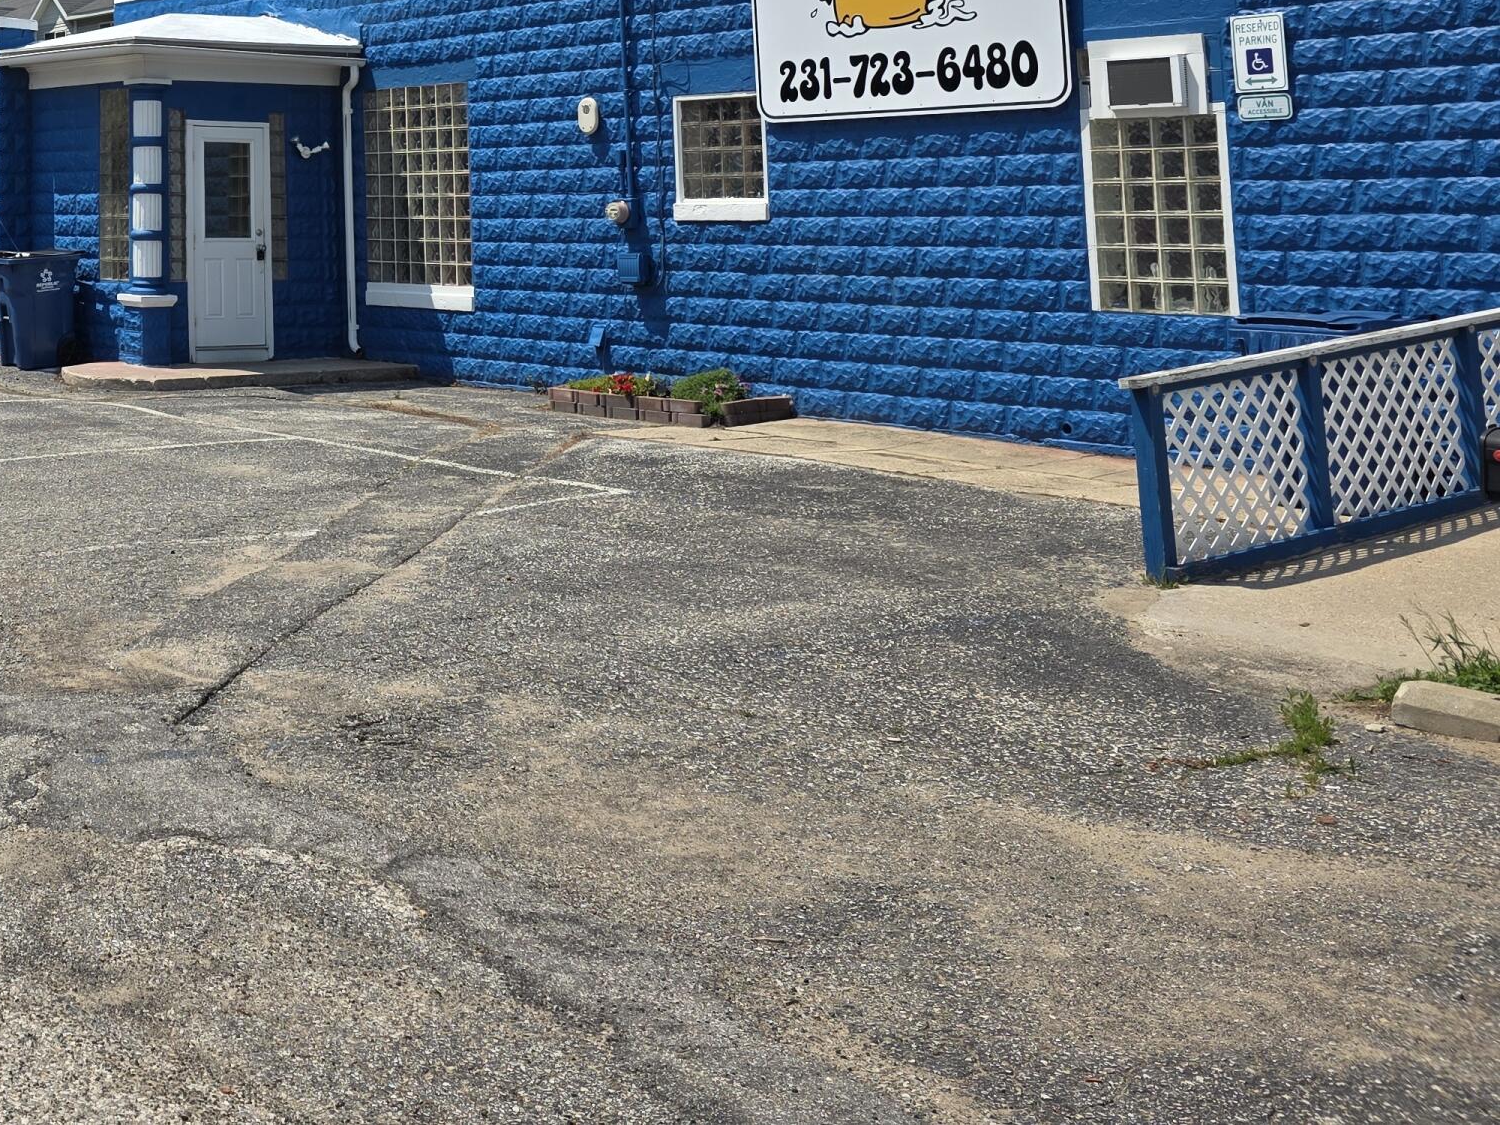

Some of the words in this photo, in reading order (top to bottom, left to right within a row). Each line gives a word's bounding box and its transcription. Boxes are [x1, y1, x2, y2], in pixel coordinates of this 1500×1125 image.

[1235, 21, 1279, 33] RESERVED
[1238, 34, 1277, 46] PARKING
[779, 40, 1039, 103] 231-723-6480
[1255, 99, 1274, 108] VAN
